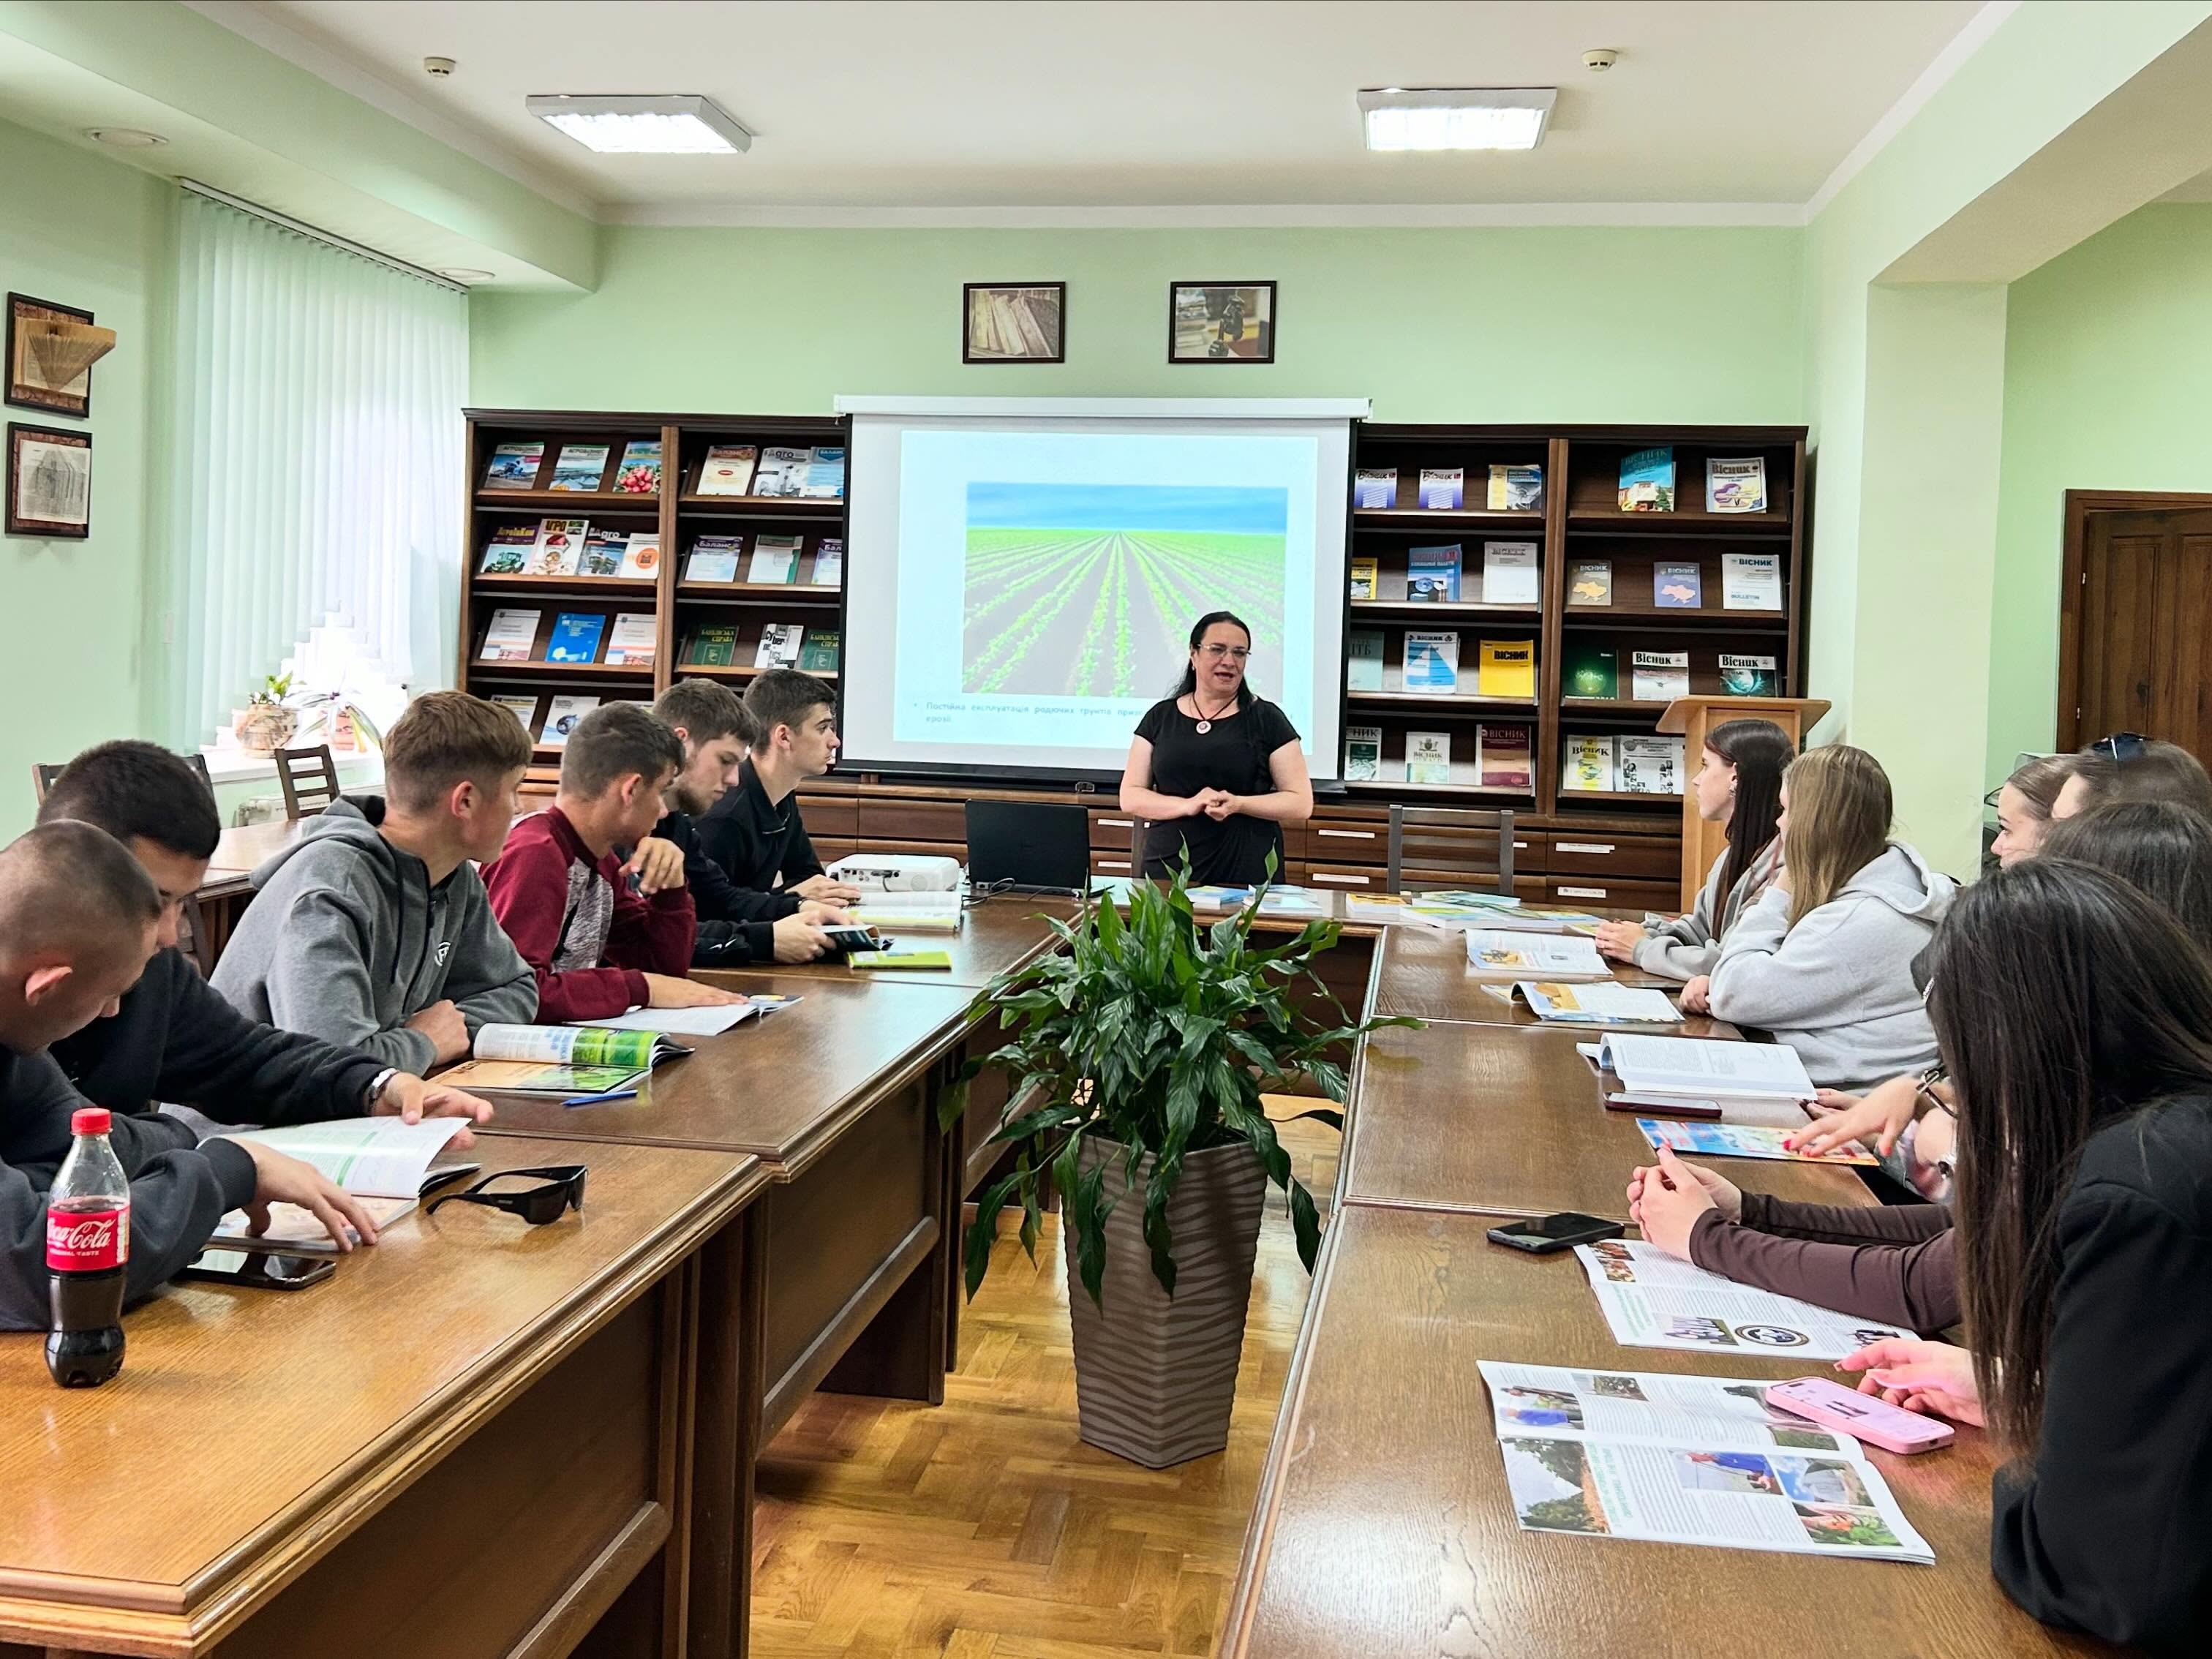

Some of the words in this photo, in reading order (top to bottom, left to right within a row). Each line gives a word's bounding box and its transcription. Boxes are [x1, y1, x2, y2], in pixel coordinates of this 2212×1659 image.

[824, 543, 842, 552] Бал
[1739, 558, 1773, 566] ВІСНИК
[1494, 650, 1529, 661] ВІСНИК
[1636, 652, 1672, 665] Вісник
[1721, 655, 1758, 667] Вісник
[1489, 729, 1527, 739] ВІСНИК
